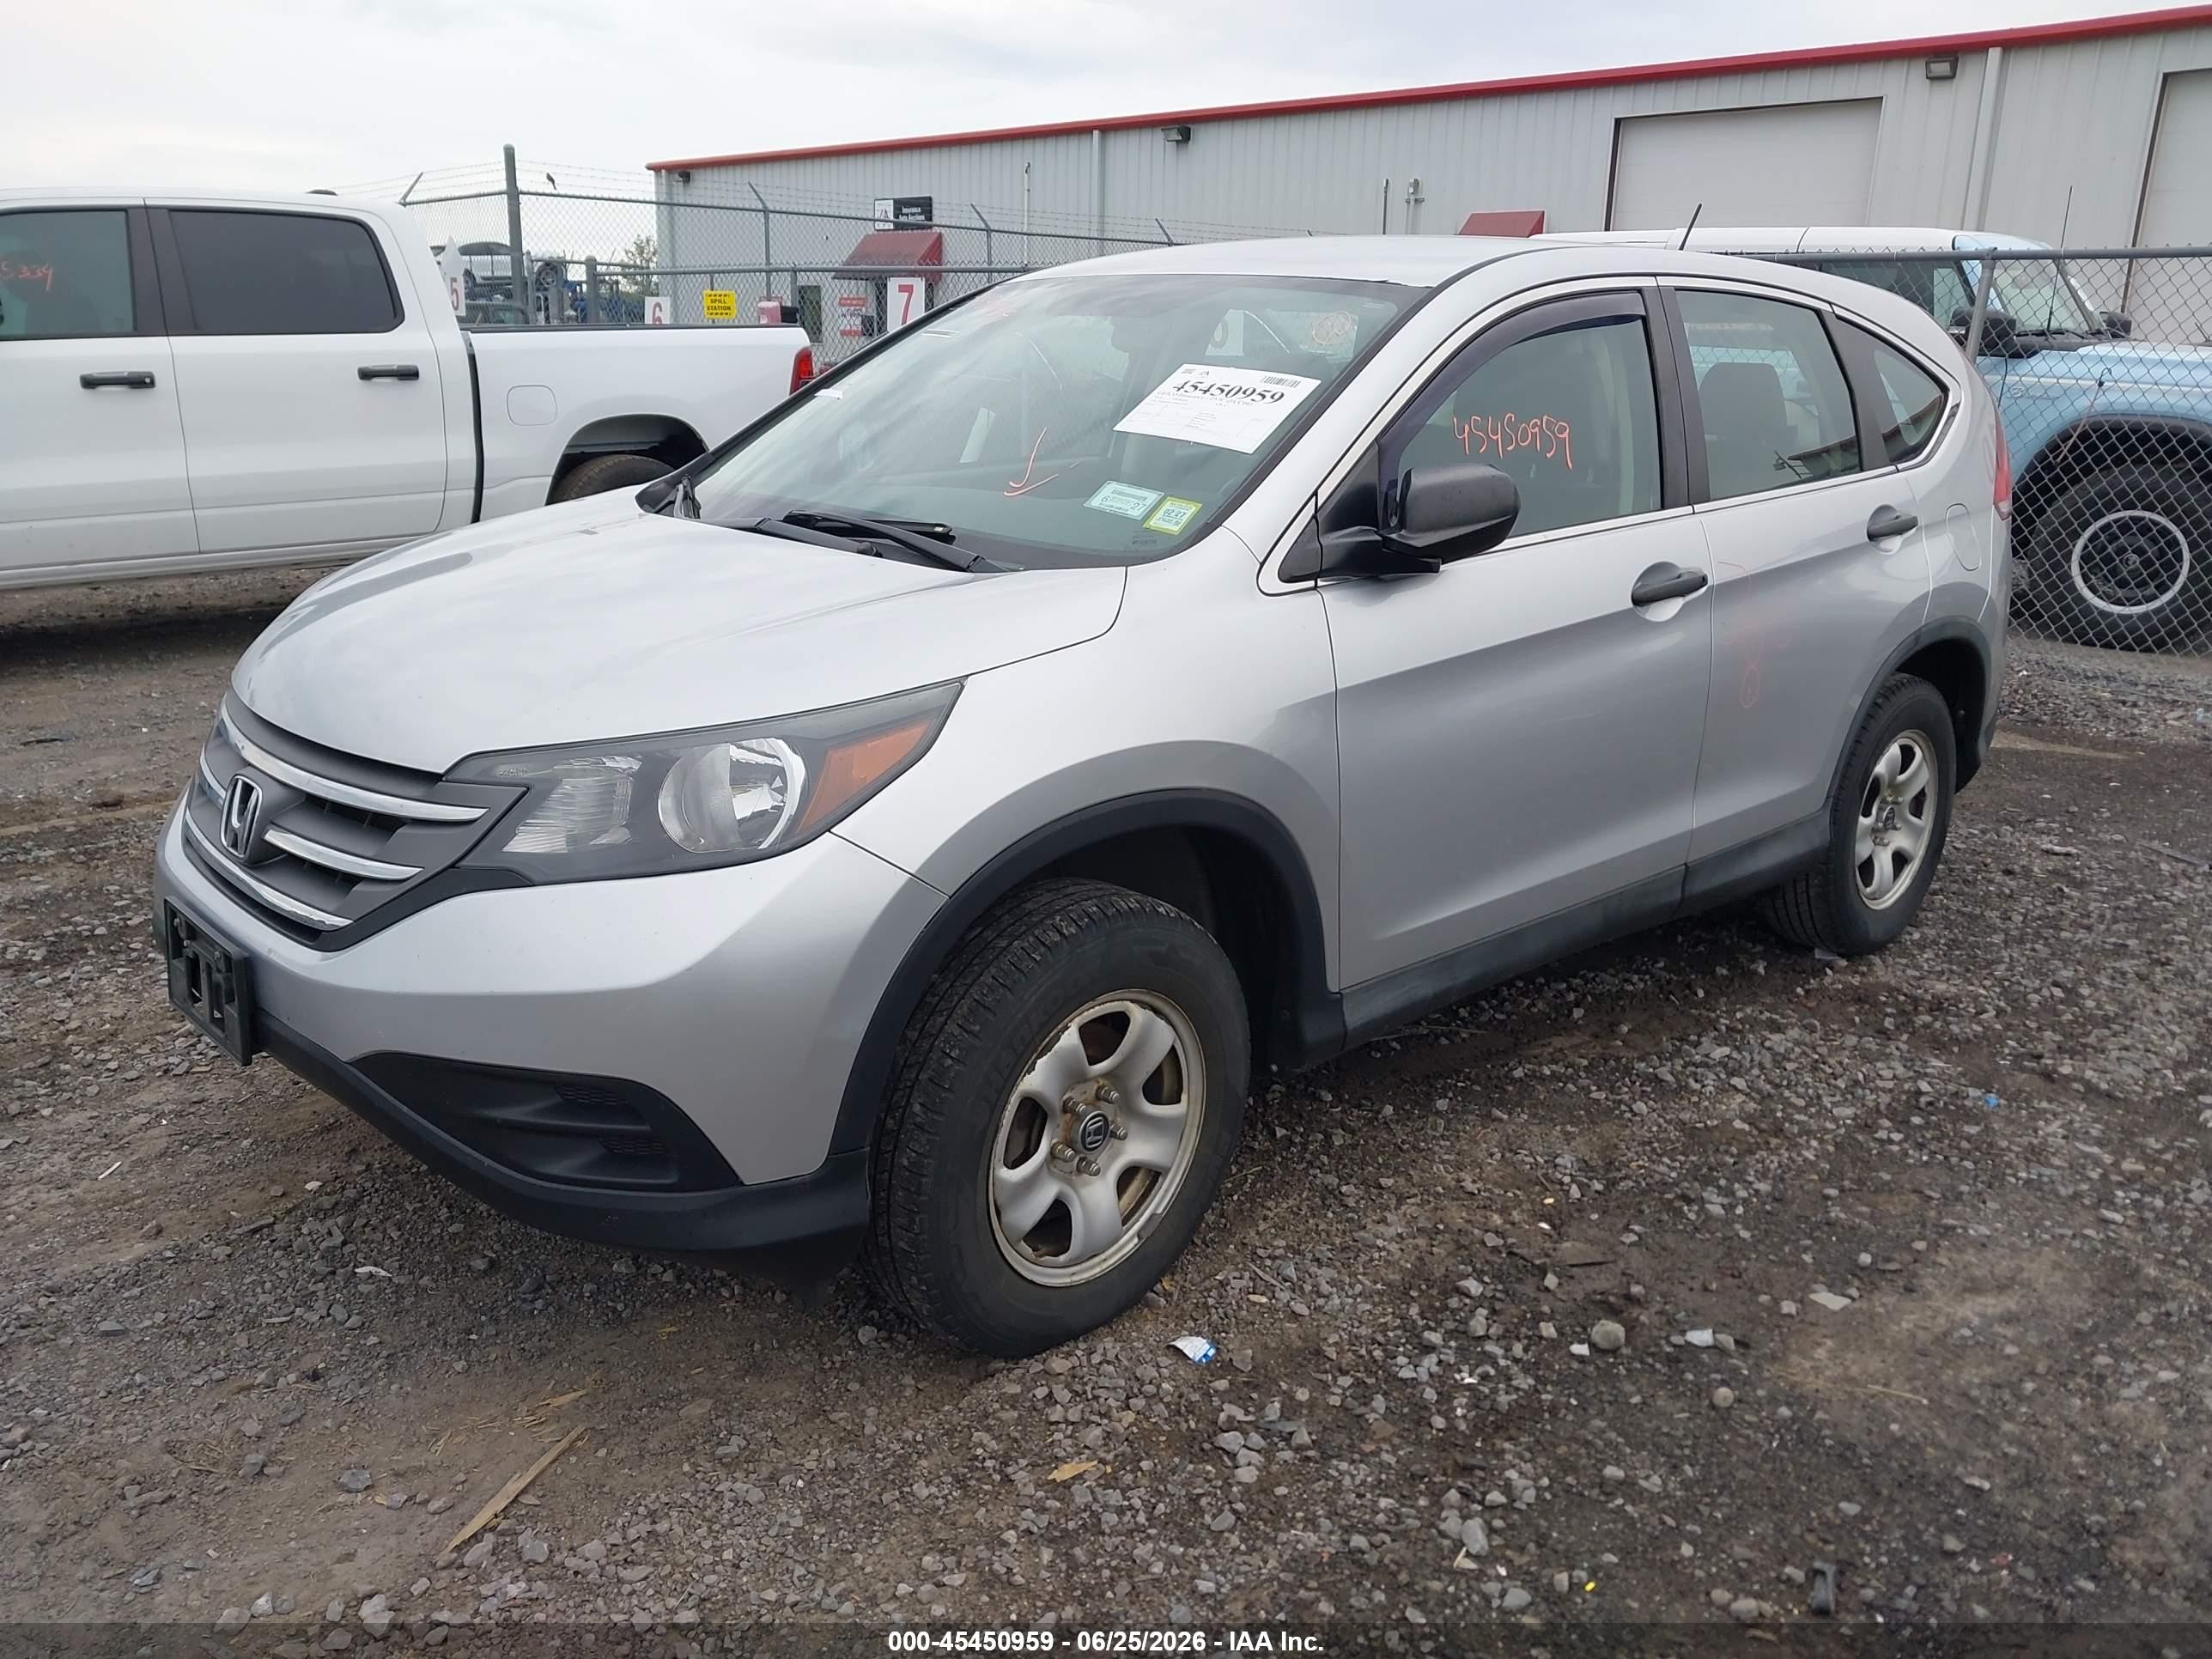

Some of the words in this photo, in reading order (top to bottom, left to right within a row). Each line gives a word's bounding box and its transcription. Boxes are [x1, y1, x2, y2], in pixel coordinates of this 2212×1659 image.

[450, 276, 459, 311] 5
[898, 283, 915, 326] 7
[651, 301, 663, 325] 6
[1172, 379, 1285, 404] 45450959
[1453, 412, 1574, 471] 45450959
